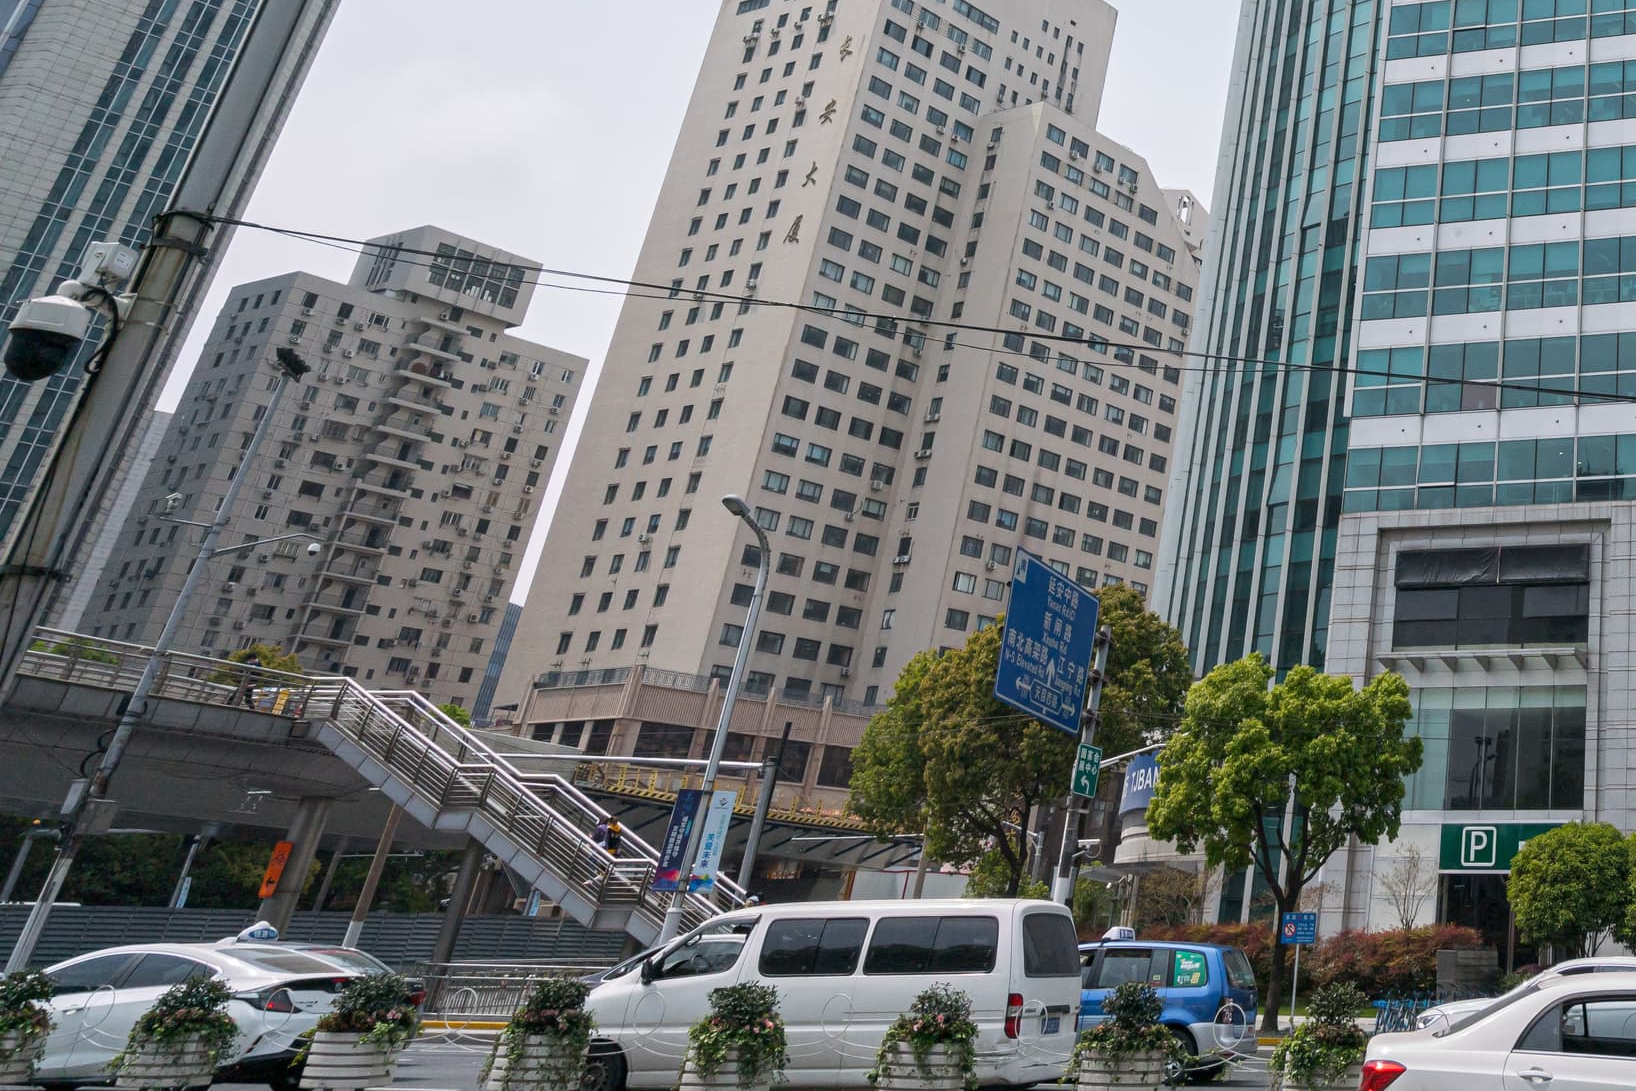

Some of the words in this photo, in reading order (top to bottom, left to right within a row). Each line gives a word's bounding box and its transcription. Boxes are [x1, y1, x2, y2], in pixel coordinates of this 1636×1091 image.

[1048, 575, 1080, 610] 延安中路
[1007, 627, 1049, 666] 南北高架路
[1056, 654, 1085, 684] 江宁路
[1469, 831, 1488, 862] P
